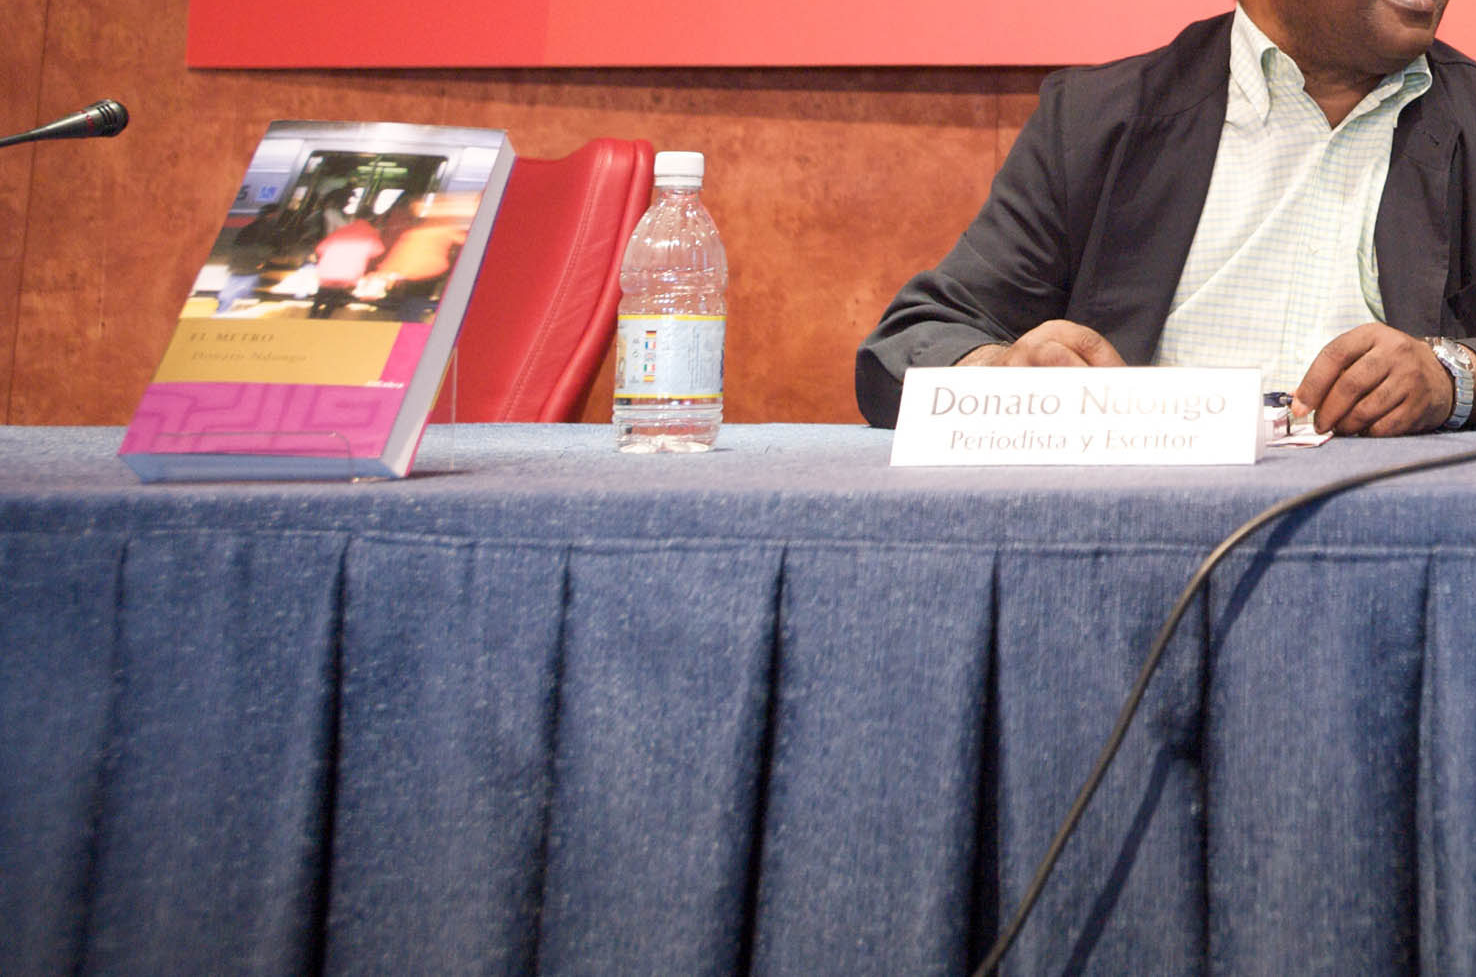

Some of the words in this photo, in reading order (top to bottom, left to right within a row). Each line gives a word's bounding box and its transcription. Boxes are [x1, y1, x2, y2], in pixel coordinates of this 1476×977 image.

[930, 386, 1062, 416] Donato
[949, 429, 1069, 450] Periodista
[1080, 433, 1094, 453] y
[1104, 429, 1199, 450] Escritor
